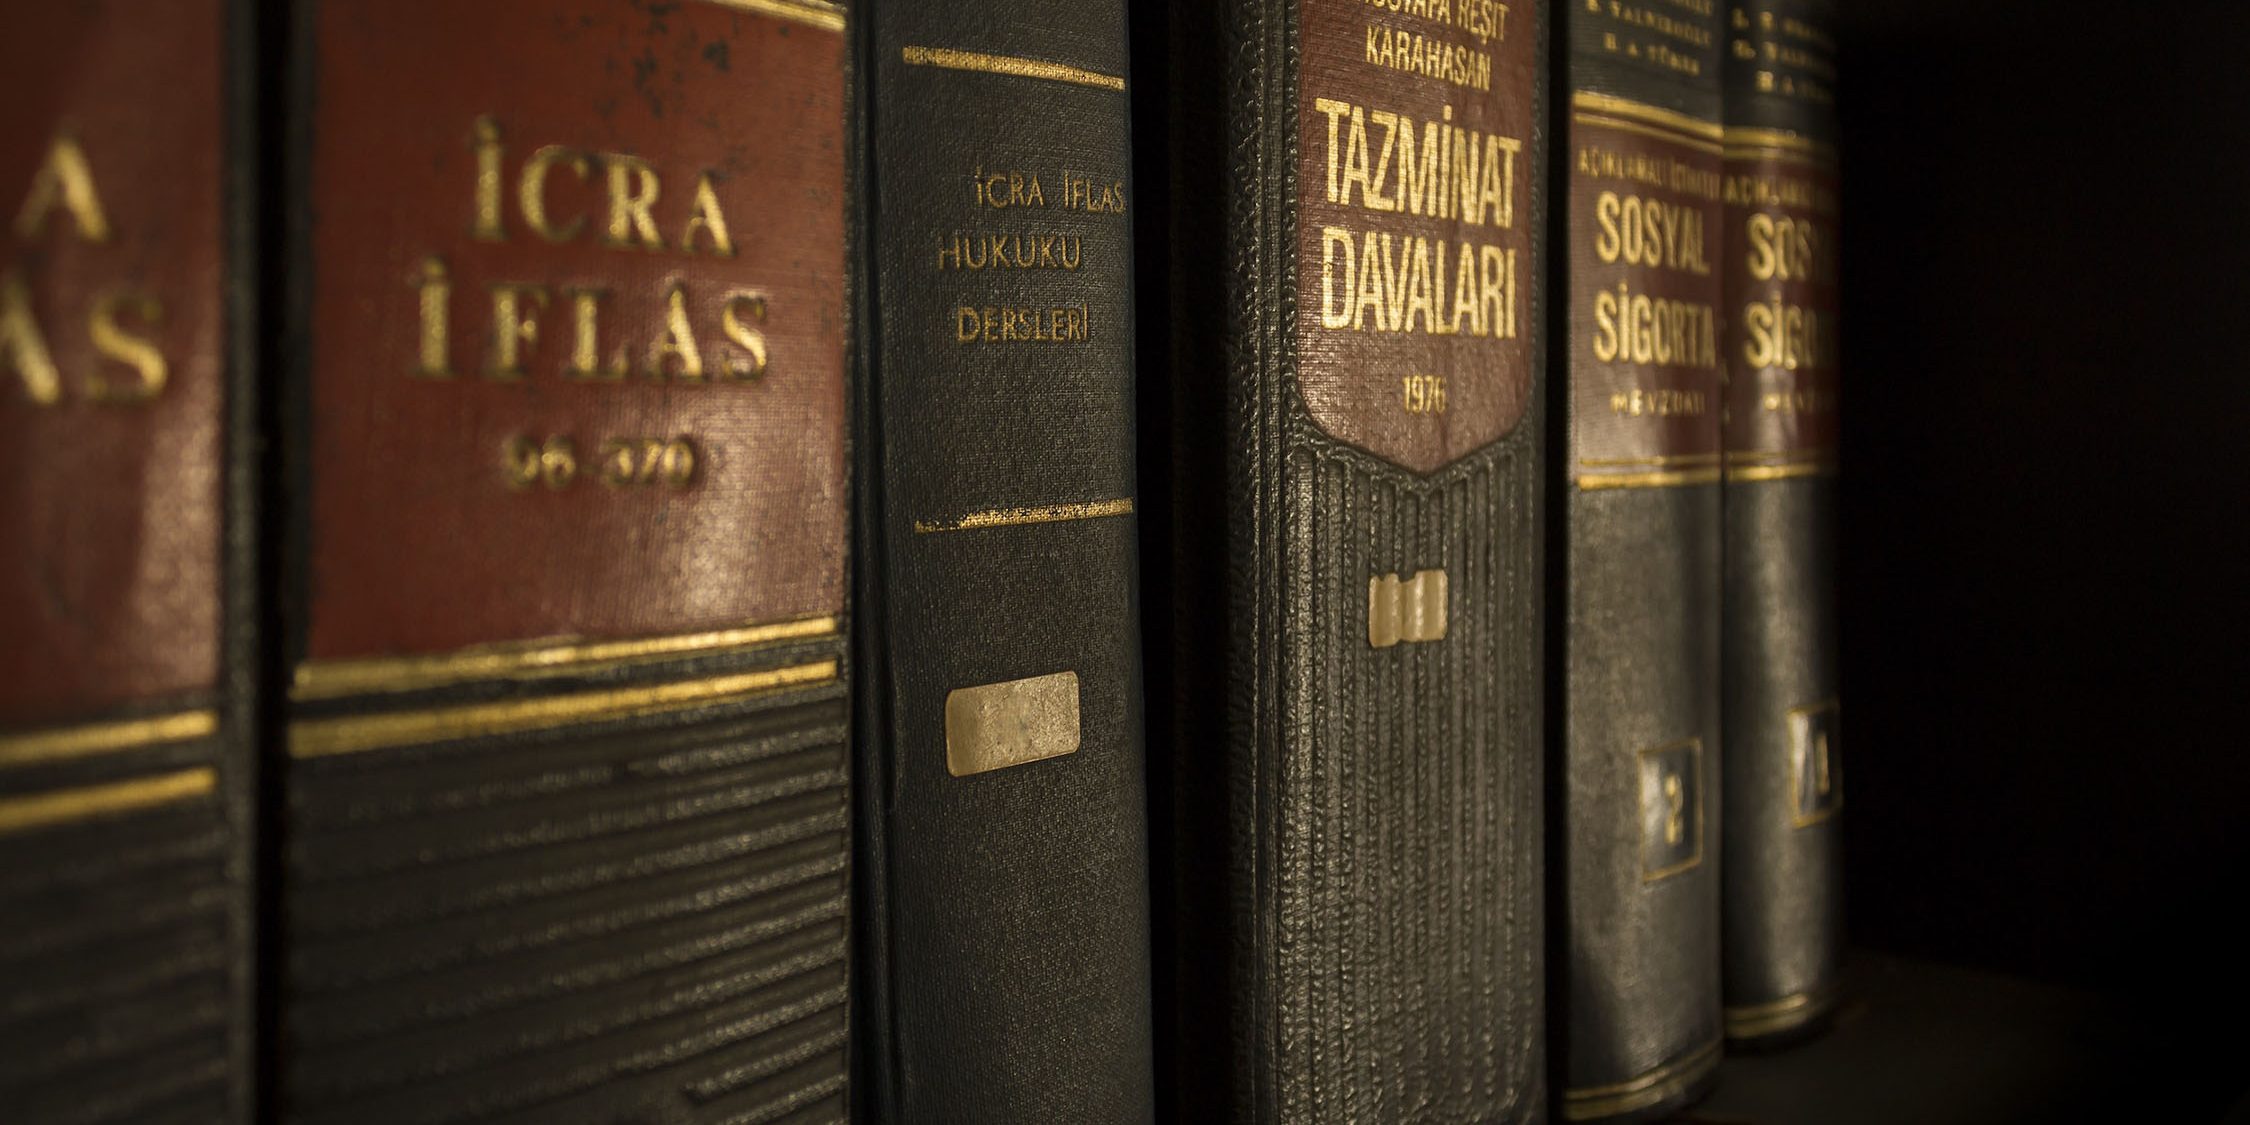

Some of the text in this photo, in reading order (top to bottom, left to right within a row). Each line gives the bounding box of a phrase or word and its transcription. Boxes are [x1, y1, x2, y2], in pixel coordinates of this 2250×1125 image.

[1366, 23, 1491, 91] KARAHASAN
[468, 114, 737, 256] İCRA
[973, 164, 1045, 209] İCRA
[1315, 97, 1522, 229] TAZMİNAT
[936, 233, 1081, 270] HUKUKU
[1596, 190, 1711, 277] SOSYAL
[1321, 226, 1517, 338] DAVALARI
[1593, 278, 1717, 368] SİGORTA
[1402, 375, 1447, 414] 1976
